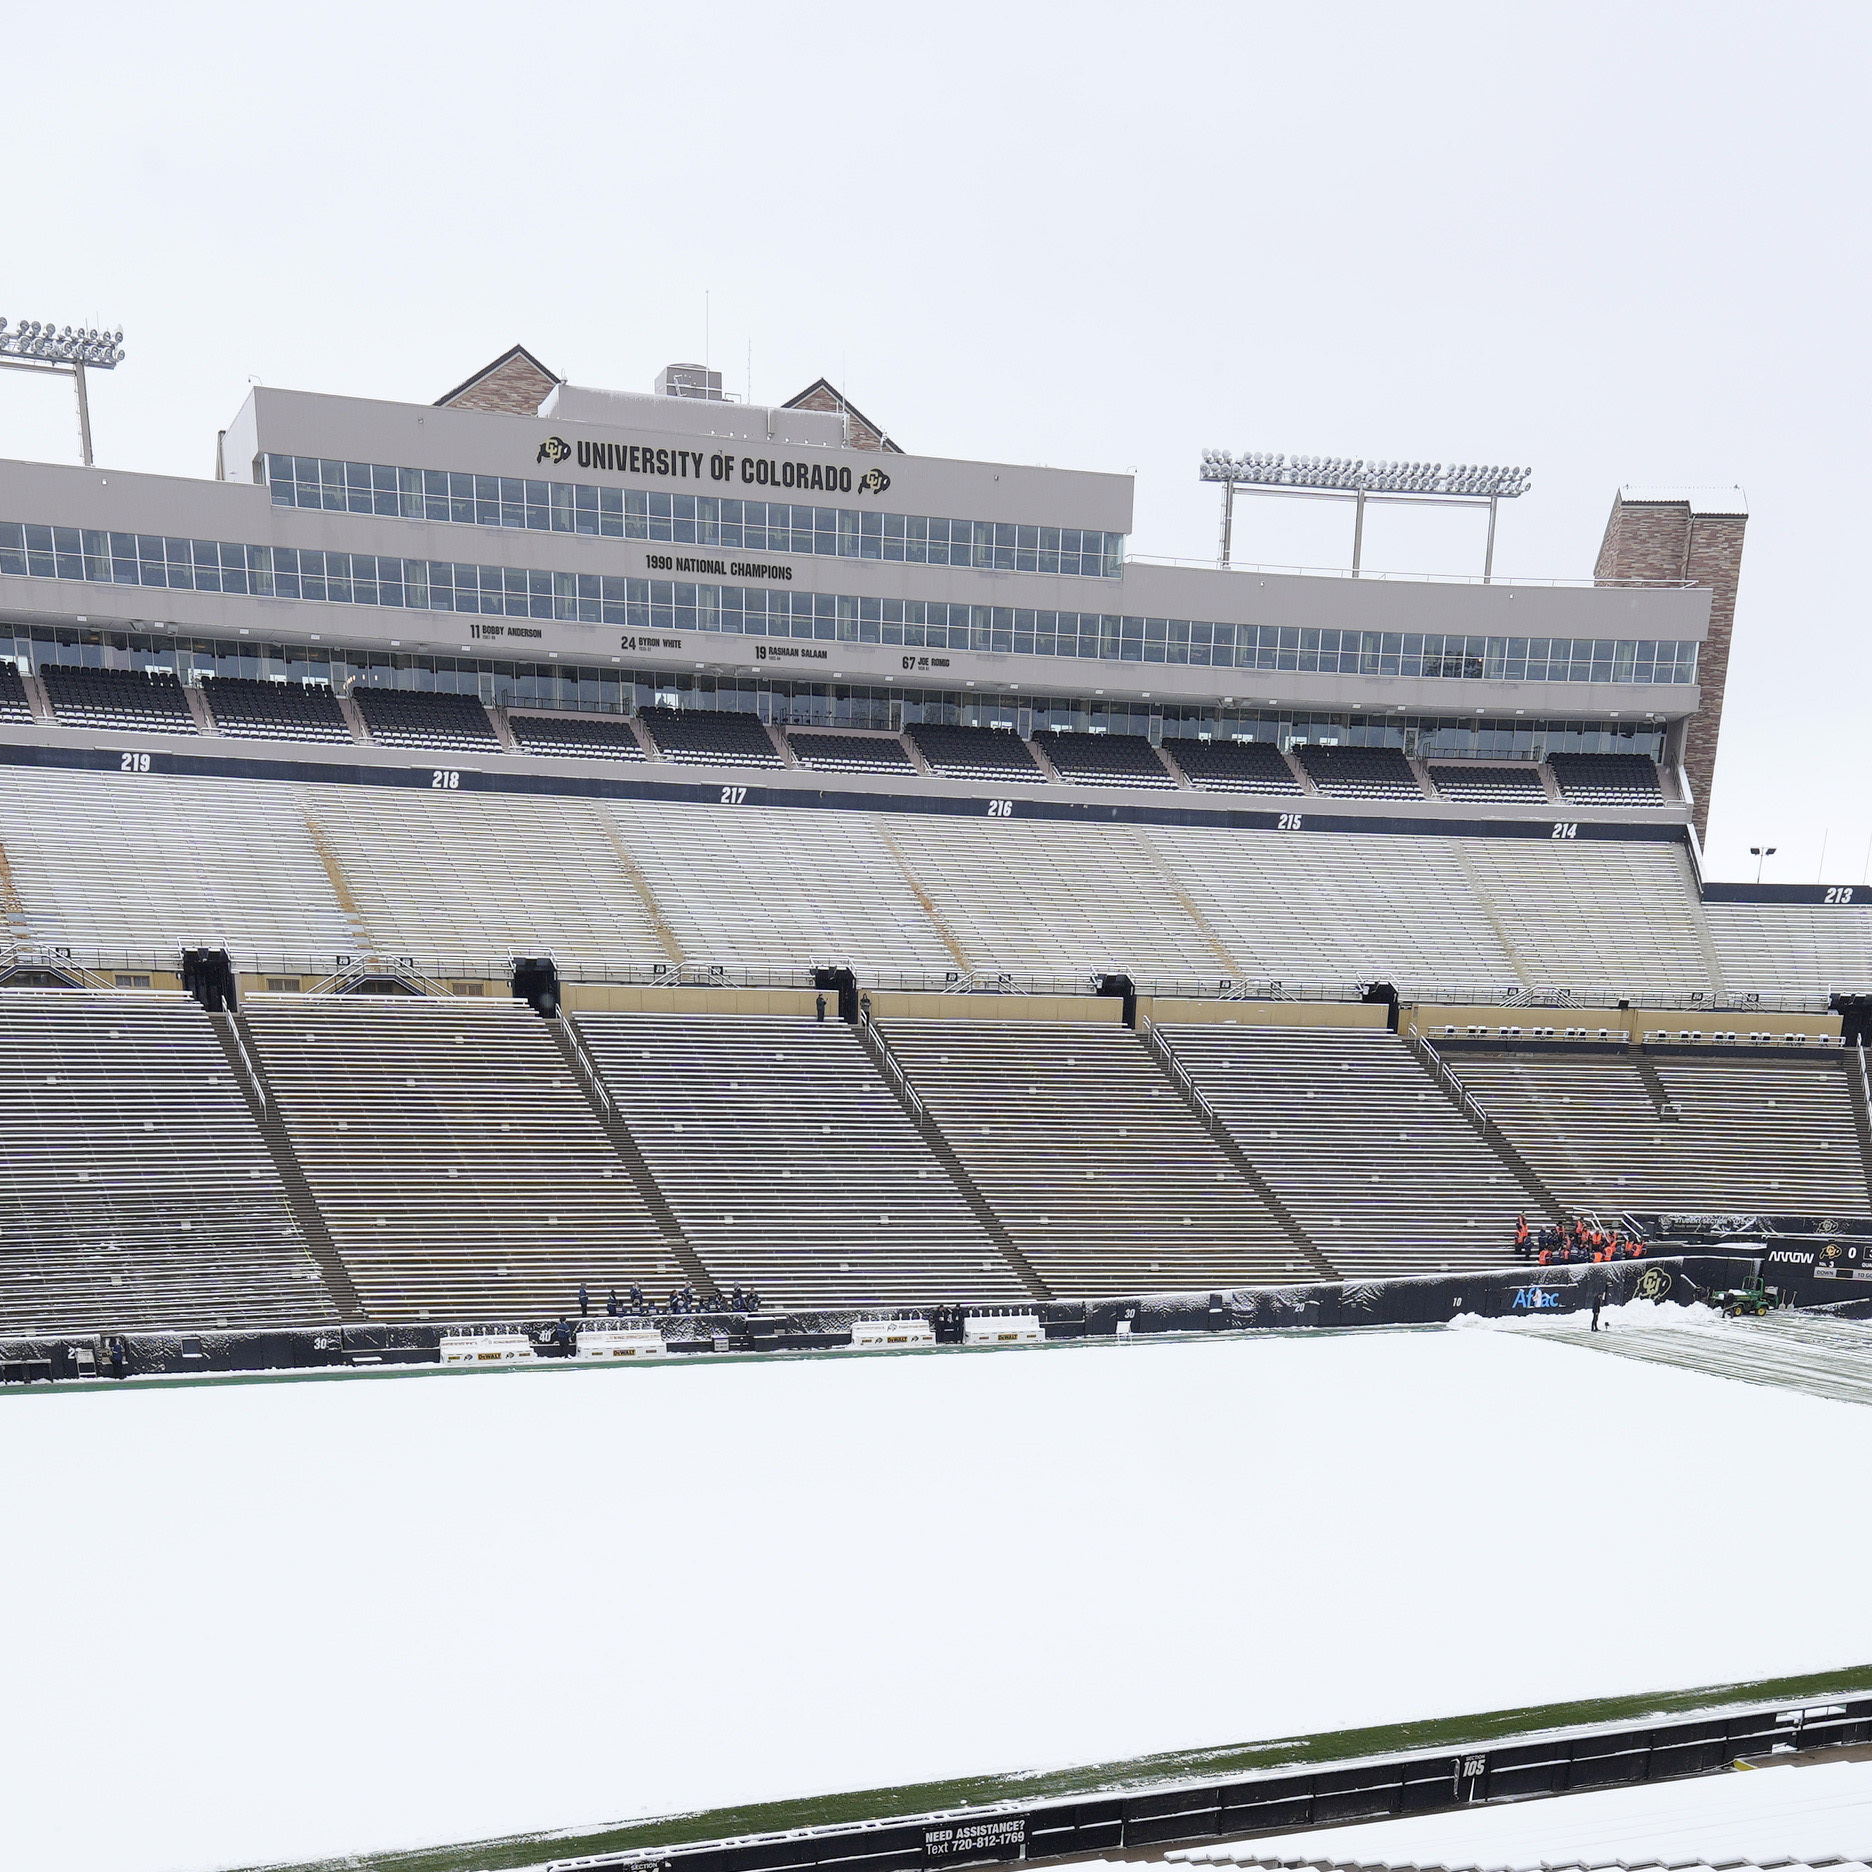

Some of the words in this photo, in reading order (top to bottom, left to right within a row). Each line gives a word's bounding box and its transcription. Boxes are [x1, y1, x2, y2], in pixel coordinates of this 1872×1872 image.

[577, 441, 703, 478] UNIVERSITY
[710, 454, 734, 481] OF
[741, 457, 852, 493] COLORADO
[646, 554, 673, 571] 1990
[676, 556, 727, 576] NATIONAL
[730, 561, 793, 581] CHAMPIONS
[470, 624, 481, 639] 11
[482, 625, 504, 635] BOBBY
[507, 627, 542, 638] ANDERSON
[621, 636, 636, 650] 24
[638, 637, 660, 647] BYRON
[662, 639, 682, 649] WHITE
[755, 646, 766, 660] 19
[768, 646, 799, 657] RASHAAN
[801, 648, 827, 659] SALAAM
[902, 656, 916, 670] 67
[917, 657, 929, 666] JOE
[121, 753, 151, 772] 219
[432, 770, 460, 789] 218
[721, 786, 747, 804] 217
[987, 800, 1013, 817] 216
[1277, 814, 1302, 830] 215
[1552, 823, 1578, 839] 214
[1824, 887, 1853, 904] 213
[1768, 1250, 1815, 1264] ARROW
[1847, 1246, 1857, 1259] 0
[1829, 1260, 1835, 1268] 3
[1816, 1269, 1834, 1277] DOWN
[1512, 1287, 1560, 1308] Aflac
[1124, 1308, 1136, 1319] 30
[1294, 1302, 1306, 1313] 20
[313, 1338, 327, 1350] 30
[538, 1331, 551, 1343] 40
[1462, 1759, 1486, 1778] 105
[925, 1829, 954, 1844] NEED
[956, 1819, 1025, 1839] ASSISTANCE?
[925, 1841, 949, 1856] Text
[951, 1831, 1025, 1852] 720-812-1769
[630, 1862, 658, 1871] SECTION
